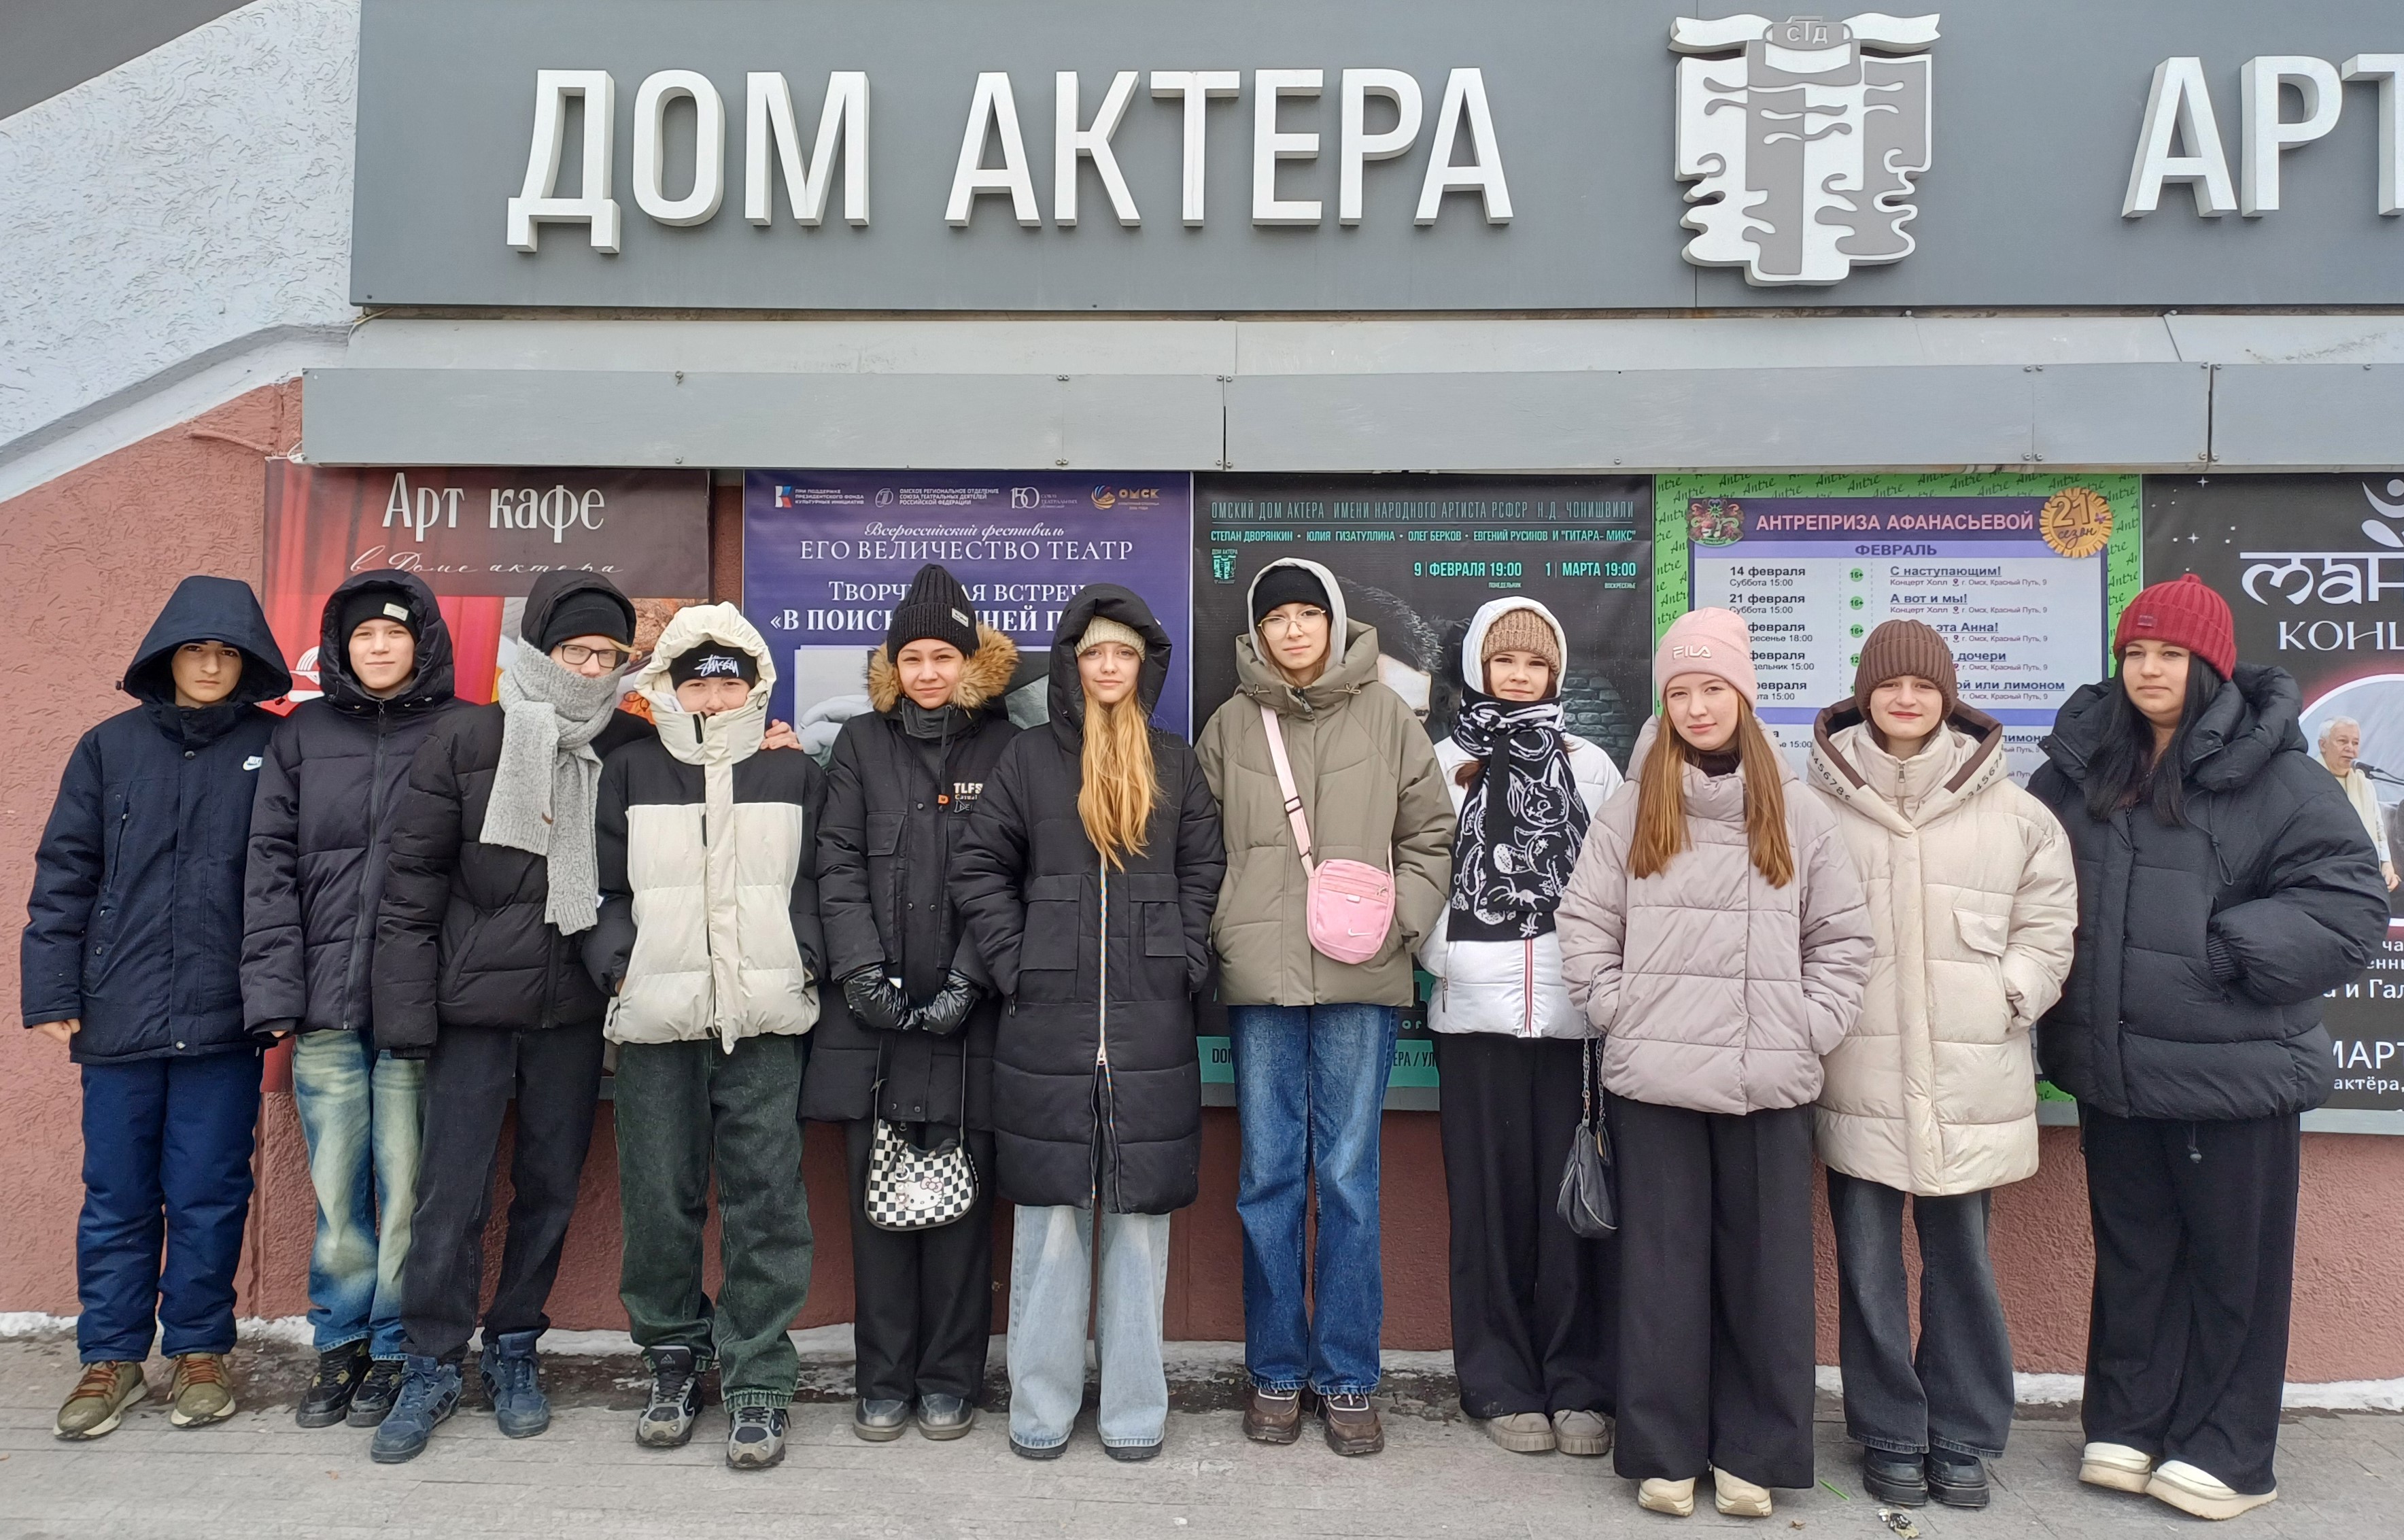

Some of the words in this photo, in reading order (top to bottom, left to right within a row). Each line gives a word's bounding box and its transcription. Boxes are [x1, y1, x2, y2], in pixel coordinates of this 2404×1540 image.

[1786, 19, 1828, 44] СТД
[507, 68, 870, 254] ДОМ
[946, 67, 1514, 226] АКТЕРА
[1118, 488, 1160, 499] ОМСК
[381, 472, 466, 543] Арт
[489, 484, 606, 543] кафе
[1212, 500, 1254, 519] ОМСКИЙ
[1259, 502, 1282, 520] ДОМ
[1287, 502, 1324, 519] АКТЕРА
[1334, 502, 1369, 519] ИМЕНИ
[1375, 502, 1436, 520] НАРОДНОГО
[1441, 501, 1486, 519] АРТИСТА
[1492, 501, 1528, 518] РСФСР
[1566, 501, 1634, 518] ЧОНИШВИЛИ
[2050, 492, 2091, 528] 21
[1756, 515, 1881, 530] АНТРЕПРИЗА
[1887, 510, 2033, 530] АФАНАСЬЕВОЙ
[864, 521, 978, 541] Всероссийский
[981, 521, 1065, 541] фестиваль
[1211, 531, 1241, 542] СТЕПАН
[1243, 531, 1293, 543] ДВОРЯНКИН
[1307, 531, 1330, 542] ЮЛИЯ
[1336, 531, 1395, 542] ГИЗАТУЛЛИНА
[1408, 530, 1428, 541] ОЛЕГ
[1430, 530, 1462, 541] БЕРКОВ
[1473, 529, 1508, 541] ЕВГЕНИЙ
[1511, 530, 1548, 541] РУСИНОВ
[1552, 530, 1558, 541] И
[2058, 528, 2097, 550] сезон
[800, 541, 850, 560] ЕГО
[857, 541, 1040, 560] ВЕЛИЧЕСТВО
[1047, 541, 1133, 560] ТЕАТР
[1855, 545, 1937, 555] ФЕВРАЛЬ
[1414, 562, 1422, 577] 9
[1429, 562, 1486, 577] ФЕВРАЛЯ
[1490, 562, 1522, 577] 19:00
[1545, 562, 1551, 576] 1
[1562, 562, 1600, 577] МАРТА
[1604, 562, 1636, 577] 19:00
[1730, 567, 1744, 576] 14
[1748, 567, 1806, 578] февраля
[1890, 566, 1900, 576] С
[1904, 566, 2001, 578] наступающим!
[1730, 579, 1767, 587] Суббота
[993, 583, 1086, 602] ВСТРЕЧ
[1730, 594, 1743, 603] 21
[1748, 594, 1805, 605] февраля
[1890, 594, 1900, 603] А
[1942, 594, 1968, 603] мы!
[974, 604, 1037, 631] НЕЙ
[1729, 606, 1767, 615] Суббота
[1770, 606, 1793, 614] 15:00
[1890, 606, 1923, 615] Концерт
[1748, 623, 1805, 634] февраля
[1936, 624, 1955, 632] эта
[1961, 622, 1998, 632] Анна!
[1750, 636, 1786, 644] ресенье
[1672, 645, 1712, 660] FILA
[1958, 652, 2006, 662] дочери
[2003, 682, 2065, 690] лимоном
[2346, 983, 2359, 998] и
